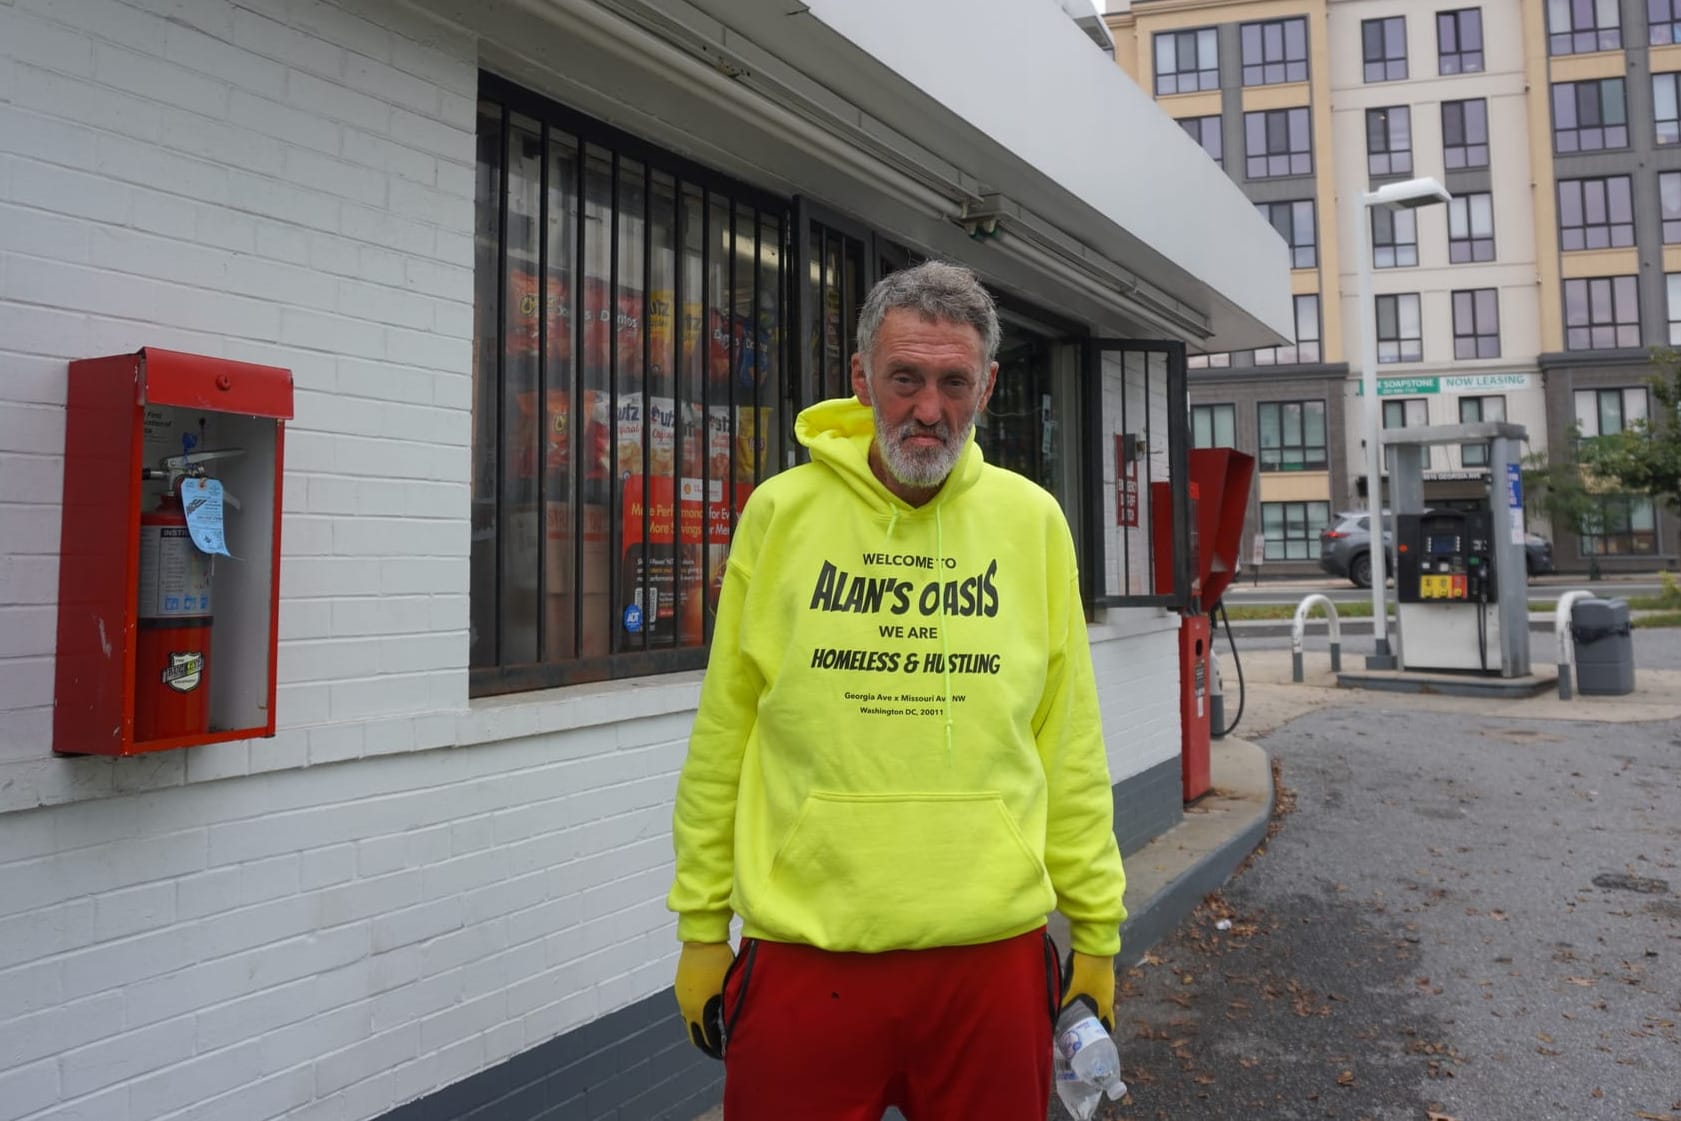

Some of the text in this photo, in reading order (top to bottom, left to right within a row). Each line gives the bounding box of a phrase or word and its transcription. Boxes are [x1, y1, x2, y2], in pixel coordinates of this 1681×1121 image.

[600, 309, 638, 328] Dritos
[1383, 379, 1434, 388] SOAPSTONE
[1446, 375, 1525, 387] NOW LEASING
[631, 503, 655, 517] Me
[863, 553, 934, 569] WELCOME
[809, 558, 999, 618] ALAN'S OASIS
[627, 611, 640, 623] ADT
[879, 625, 938, 639] WE ARE
[811, 648, 1001, 675] HOMELESS & HUSTLING
[844, 692, 875, 702] Georgia
[877, 693, 893, 702] Ave
[901, 694, 935, 703] Missouri
[936, 695, 950, 703] Av
[952, 695, 966, 703] NW
[860, 706, 944, 717] Washington DC, 20011
